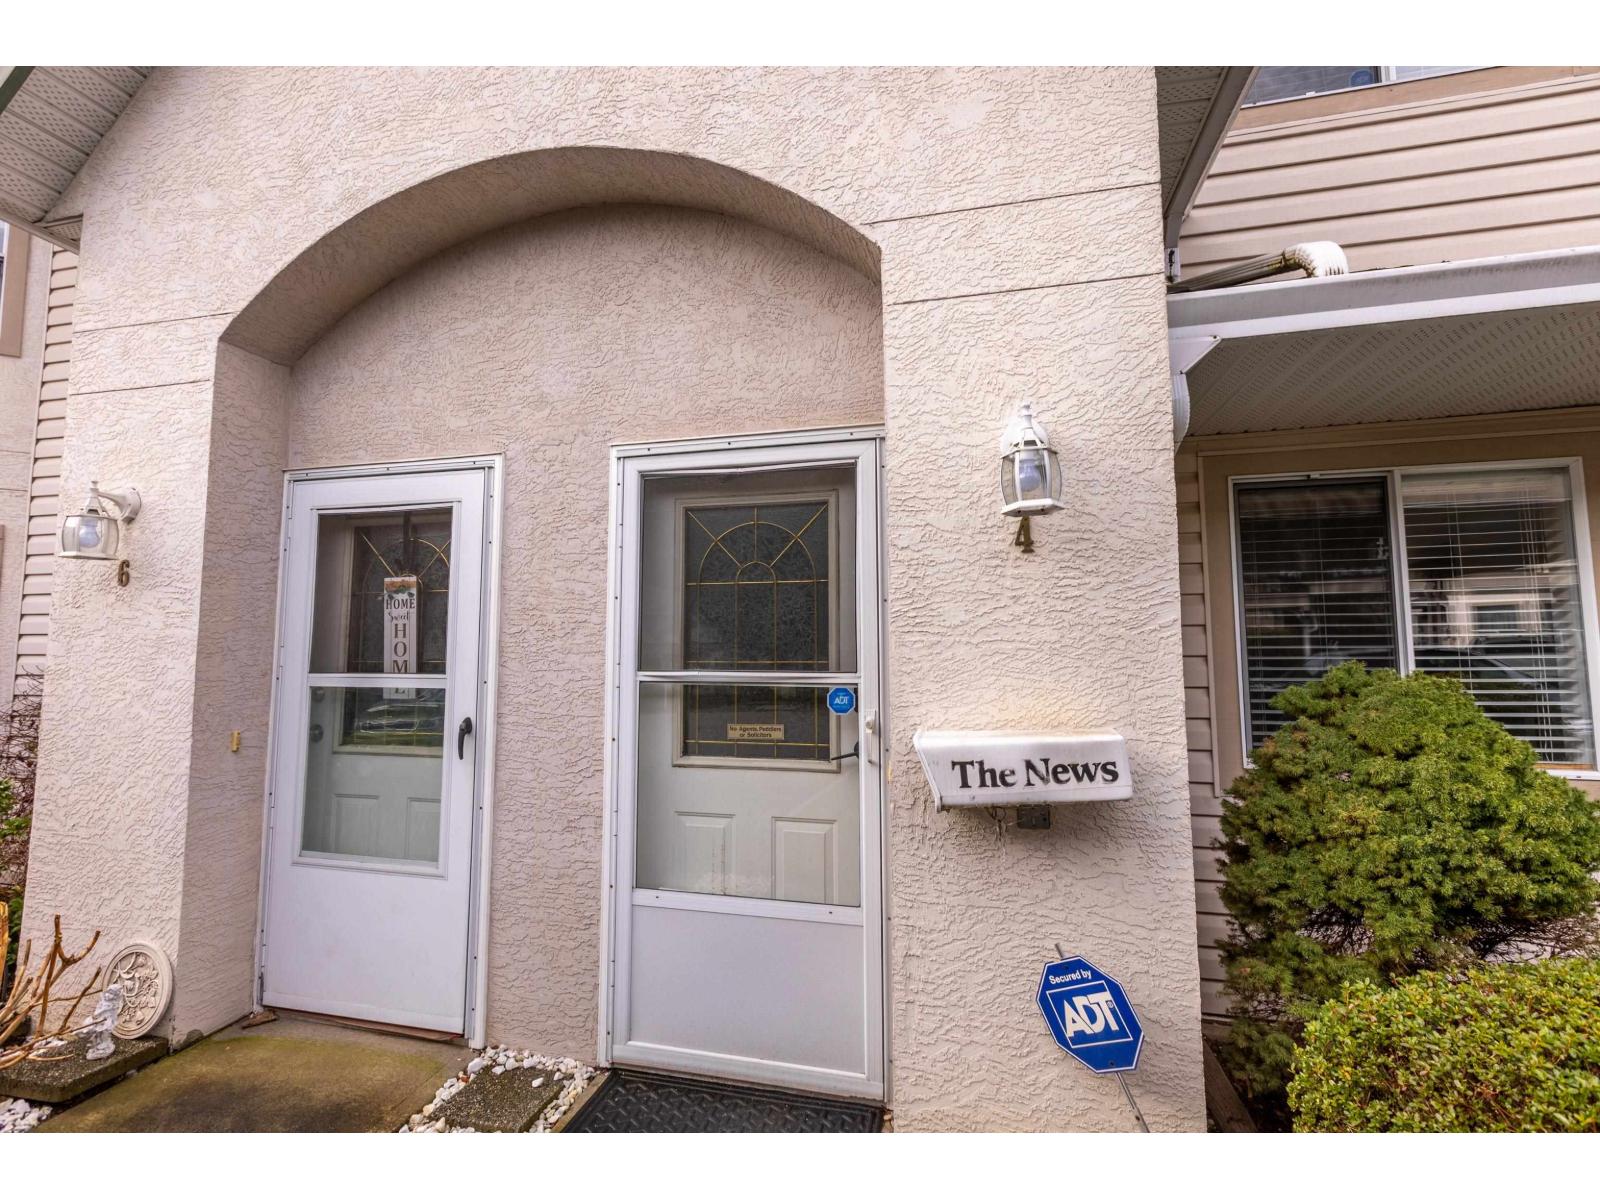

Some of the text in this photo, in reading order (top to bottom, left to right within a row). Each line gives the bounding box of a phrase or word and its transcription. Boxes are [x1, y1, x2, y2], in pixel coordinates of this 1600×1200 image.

[1014, 516, 1035, 553] 4
[118, 560, 130, 587] 6
[385, 598, 416, 610] HOME
[833, 696, 850, 705] ADT
[951, 757, 1120, 789] The News
[1048, 968, 1092, 985] Secured by
[1063, 990, 1120, 1038] ADT
